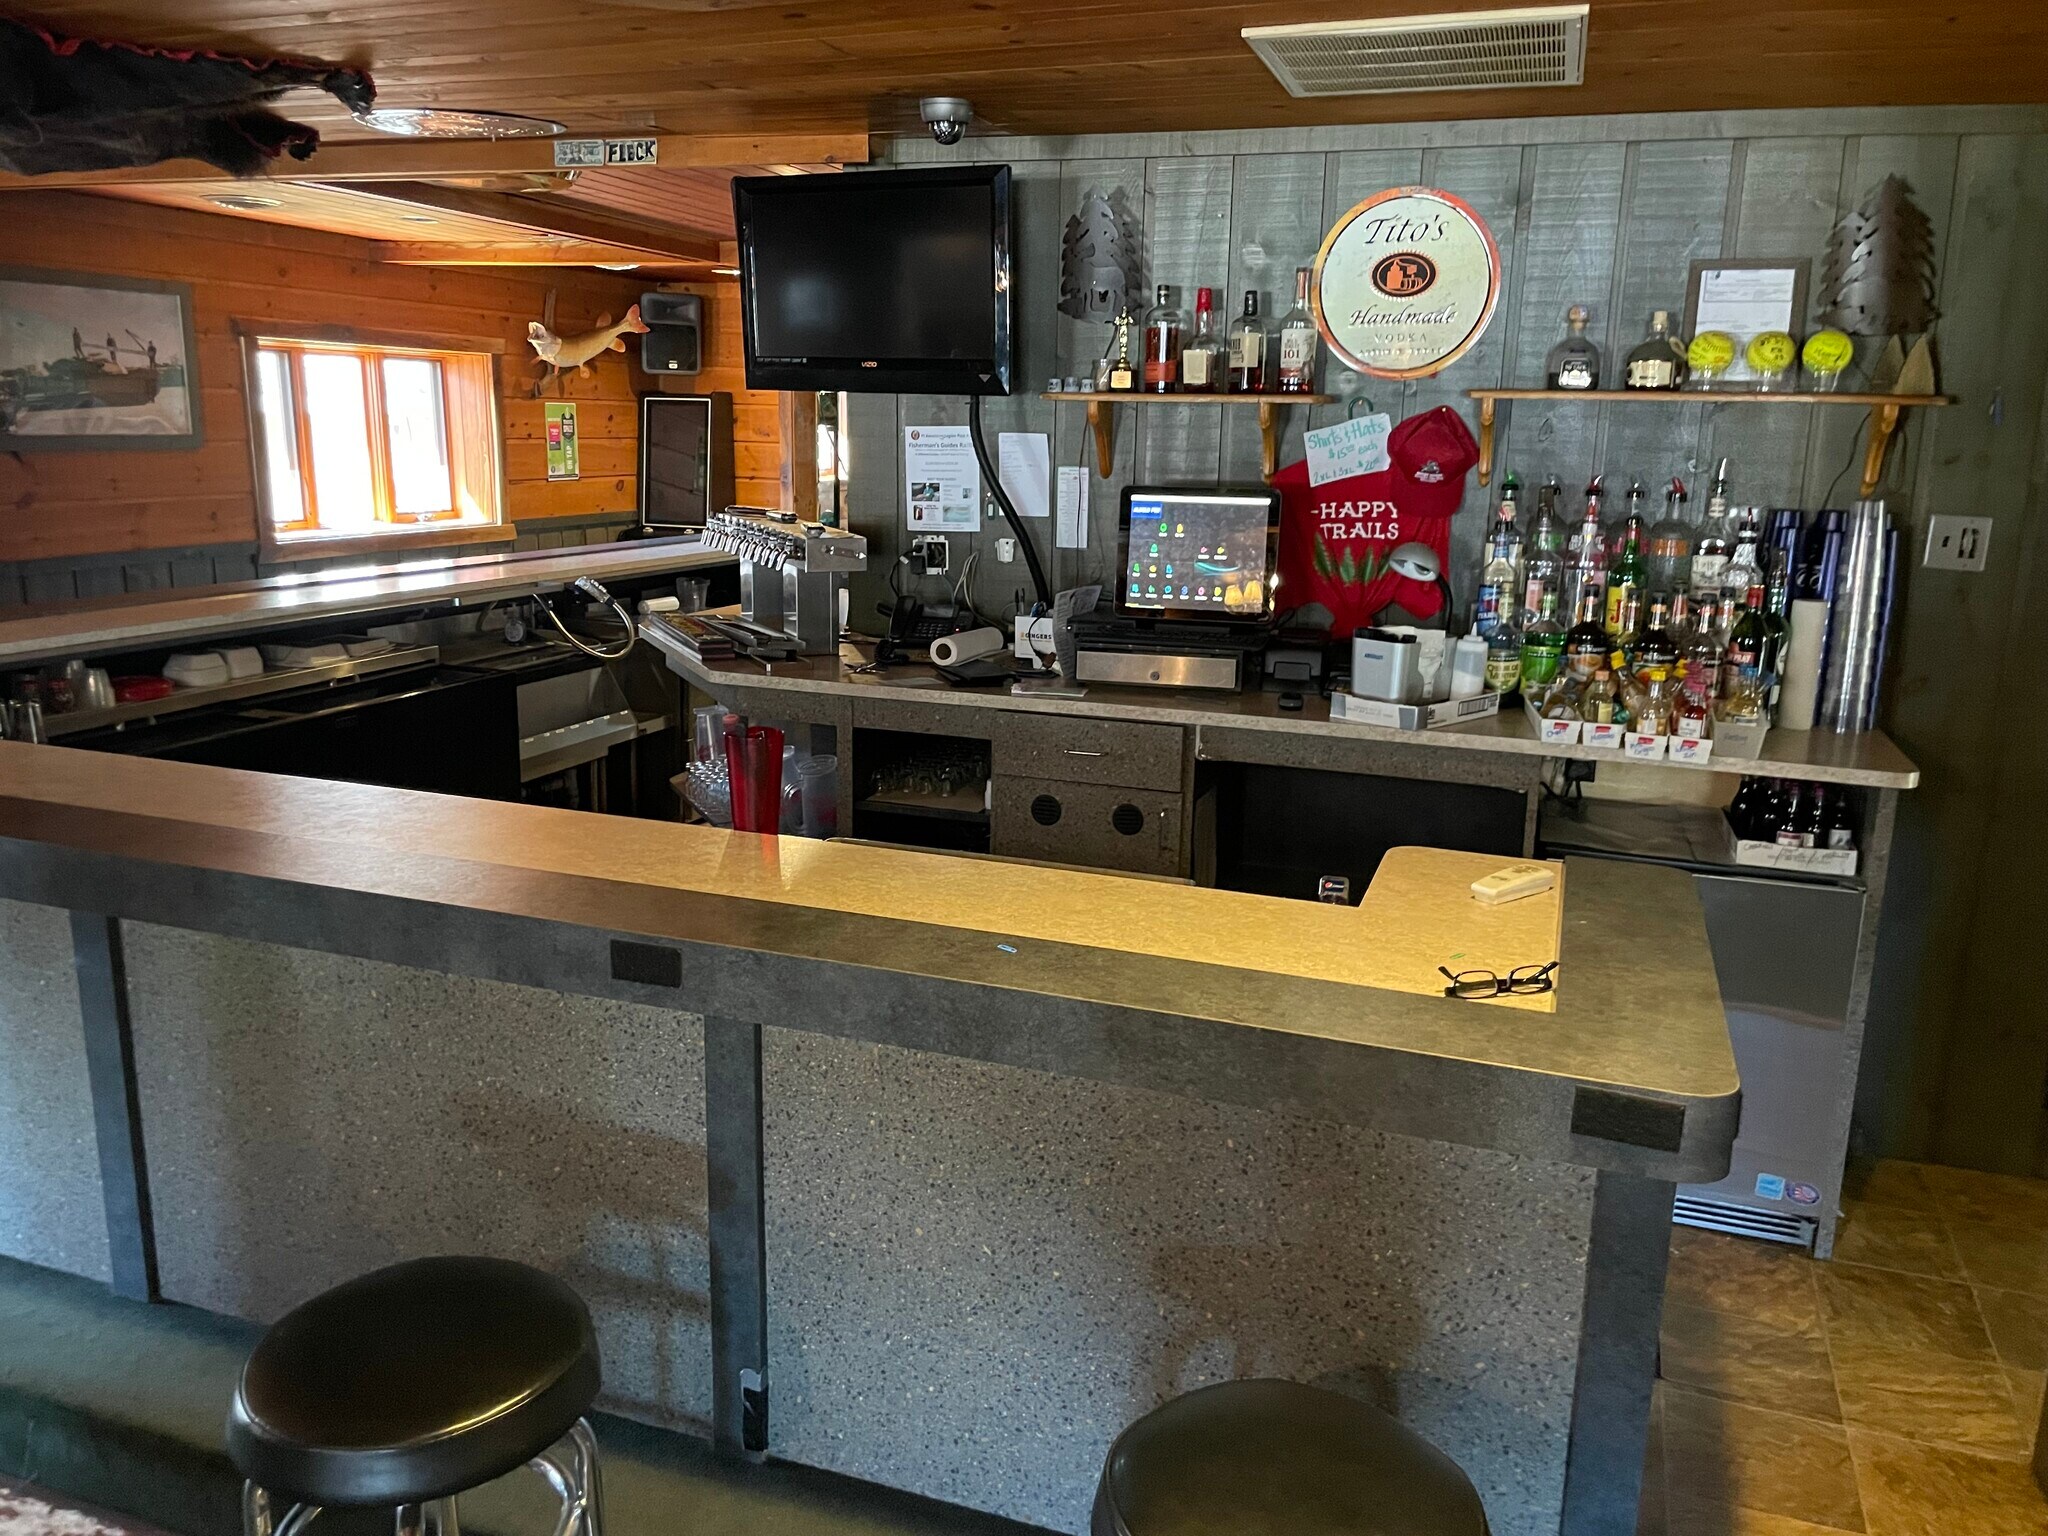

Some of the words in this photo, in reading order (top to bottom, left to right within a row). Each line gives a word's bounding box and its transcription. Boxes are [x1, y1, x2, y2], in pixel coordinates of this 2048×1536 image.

[1364, 214, 1450, 245] Tito's
[1349, 302, 1457, 327] Handmade
[1374, 332, 1427, 344] VODKA
[1284, 349, 1300, 359] 101
[1308, 428, 1343, 450] Shirts
[1351, 418, 1385, 439] Hats
[1320, 501, 1398, 519] HAPPY
[1319, 522, 1399, 540] TRAILS
